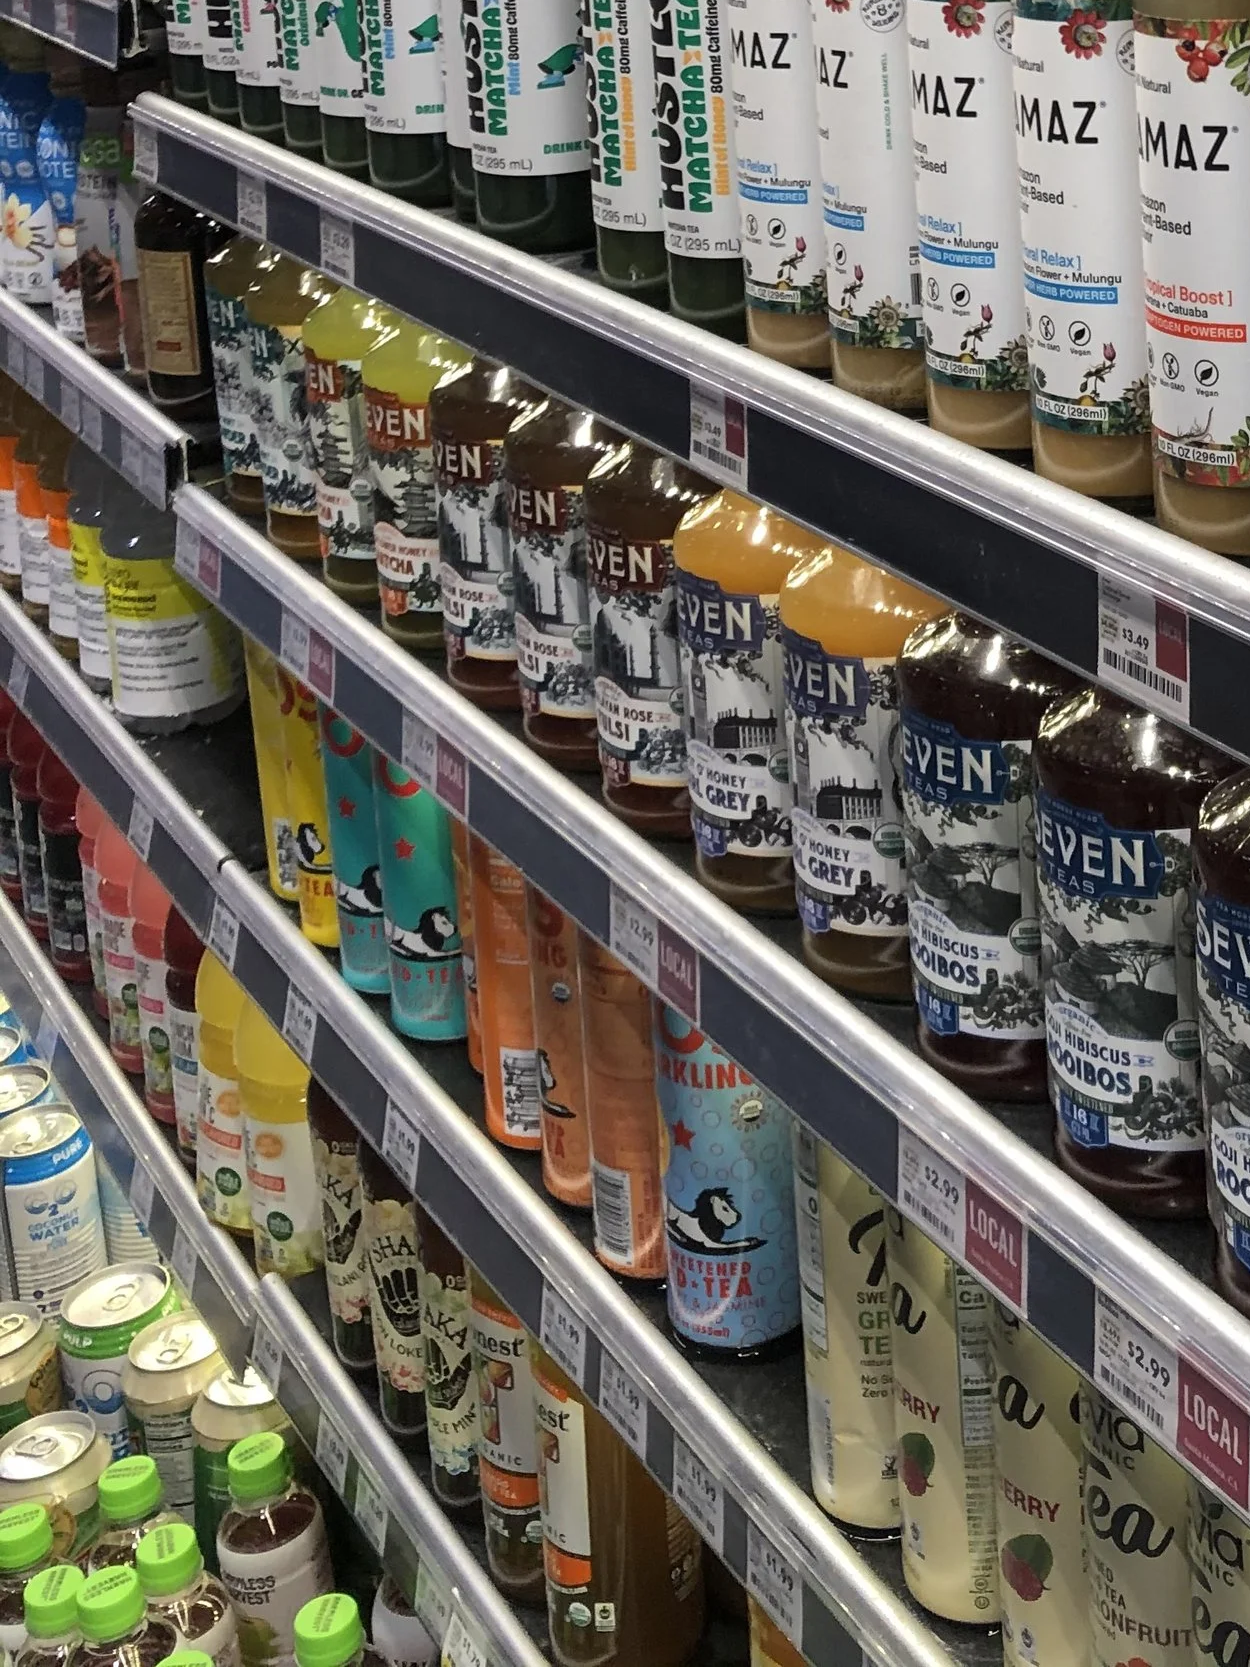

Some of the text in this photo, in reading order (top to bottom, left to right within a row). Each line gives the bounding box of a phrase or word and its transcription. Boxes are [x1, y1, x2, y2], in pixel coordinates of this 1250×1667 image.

[507, 25, 520, 60] 80mg
[619, 37, 631, 75] 80mg
[481, 6, 508, 136] MATCHA
[508, 61, 521, 96] Mint
[710, 39, 724, 95] 80mg
[596, 44, 622, 187] MATCHA
[679, 61, 714, 213] MATCHA
[685, 235, 742, 253] (295 mL)
[1041, 249, 1074, 268] Relax
[1072, 272, 1122, 288] Mulungu
[1180, 285, 1224, 305] Boost
[1122, 628, 1149, 650] $3.49
[623, 706, 654, 723] ROSE
[707, 768, 747, 789] HONEY
[705, 784, 751, 812] GREY
[809, 838, 851, 863] HONEY
[807, 856, 855, 887] GREY
[921, 925, 980, 960] HIBISCUS
[661, 940, 693, 989] LOCAL
[1064, 1031, 1131, 1067] HIBISCUS
[51, 1137, 84, 1167] PURE
[1214, 1135, 1238, 1166] GOJI
[924, 1166, 960, 1205] $2.99
[29, 1218, 79, 1242] WATER
[969, 1199, 1018, 1268] LOCAL
[1127, 1340, 1172, 1388] $2.99
[1184, 1384, 1243, 1466] LOCAL
